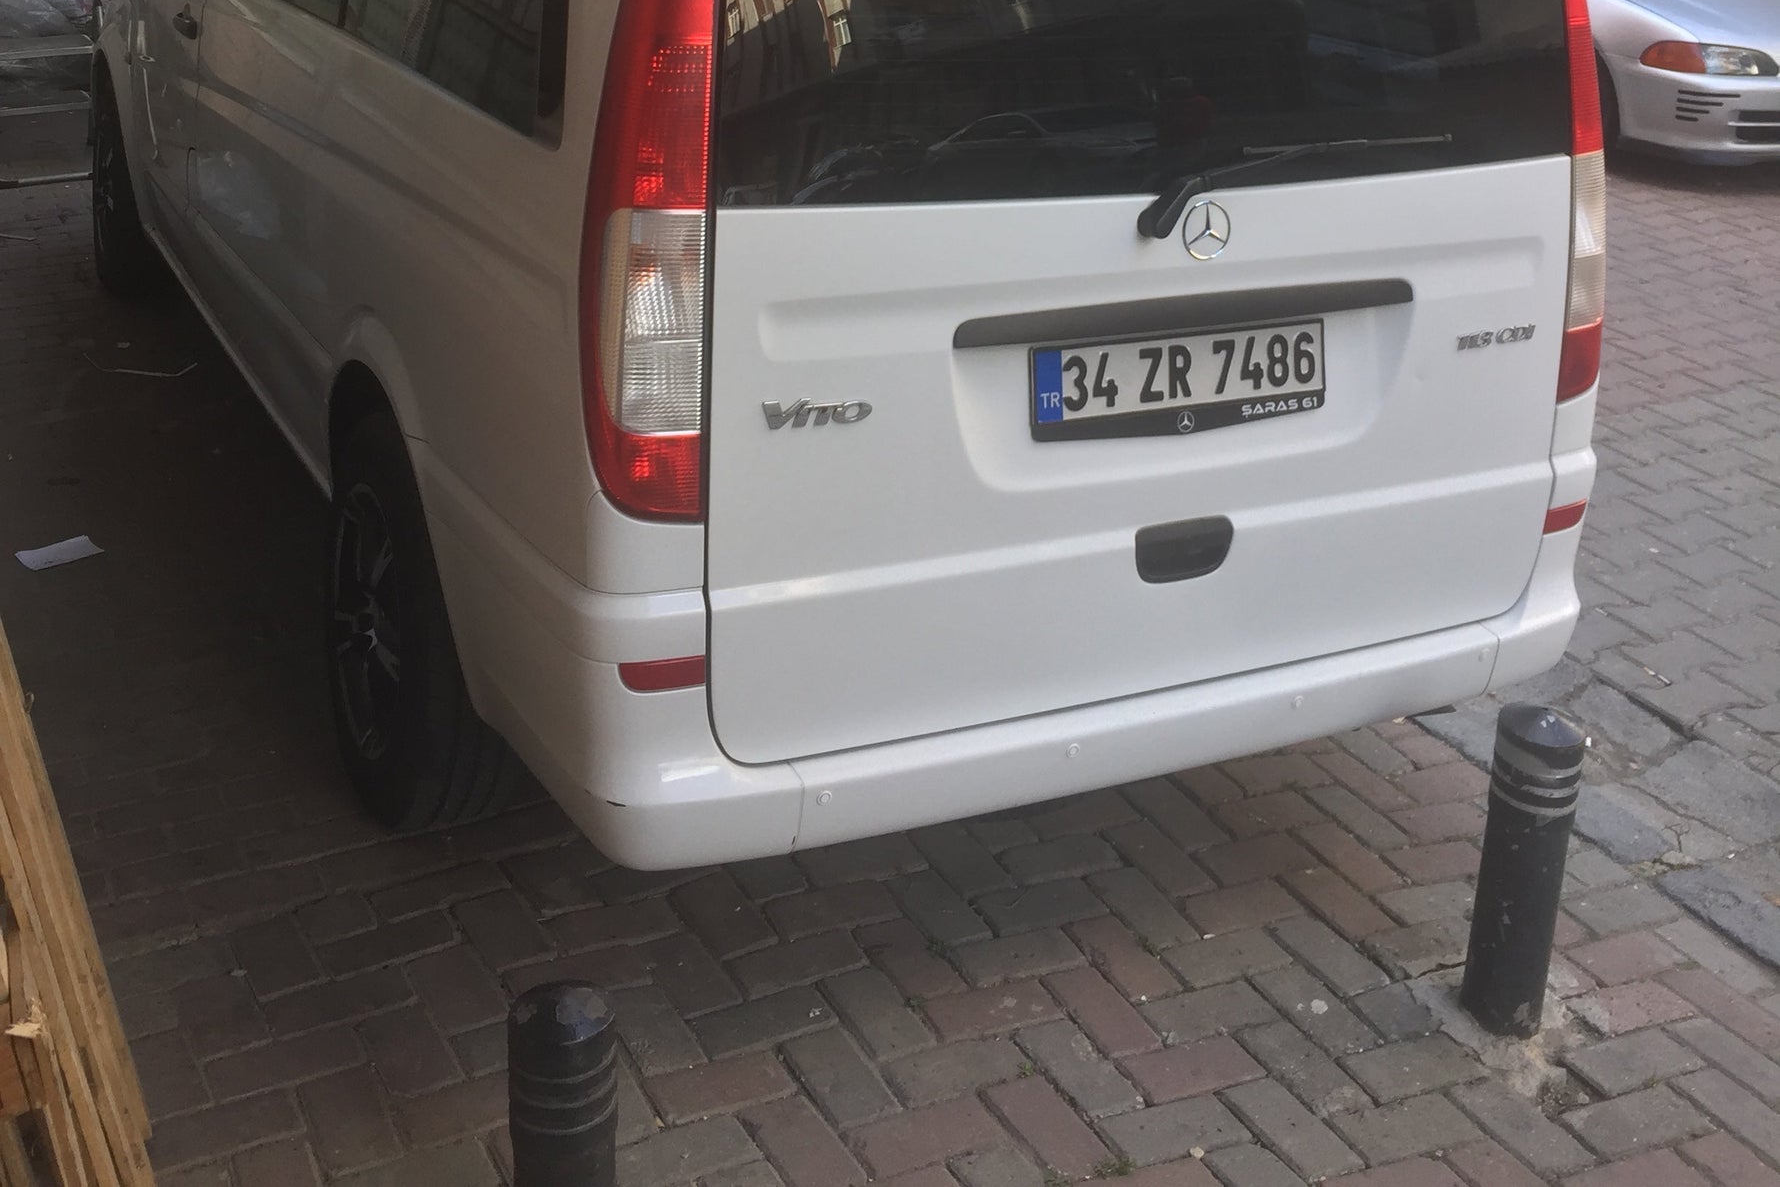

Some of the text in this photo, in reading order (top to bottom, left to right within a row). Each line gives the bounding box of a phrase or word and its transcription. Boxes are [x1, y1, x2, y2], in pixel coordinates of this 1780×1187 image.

[1062, 331, 1315, 411] 34 ZR 7486
[1040, 392, 1060, 408] TR
[1302, 396, 1318, 408] 61
